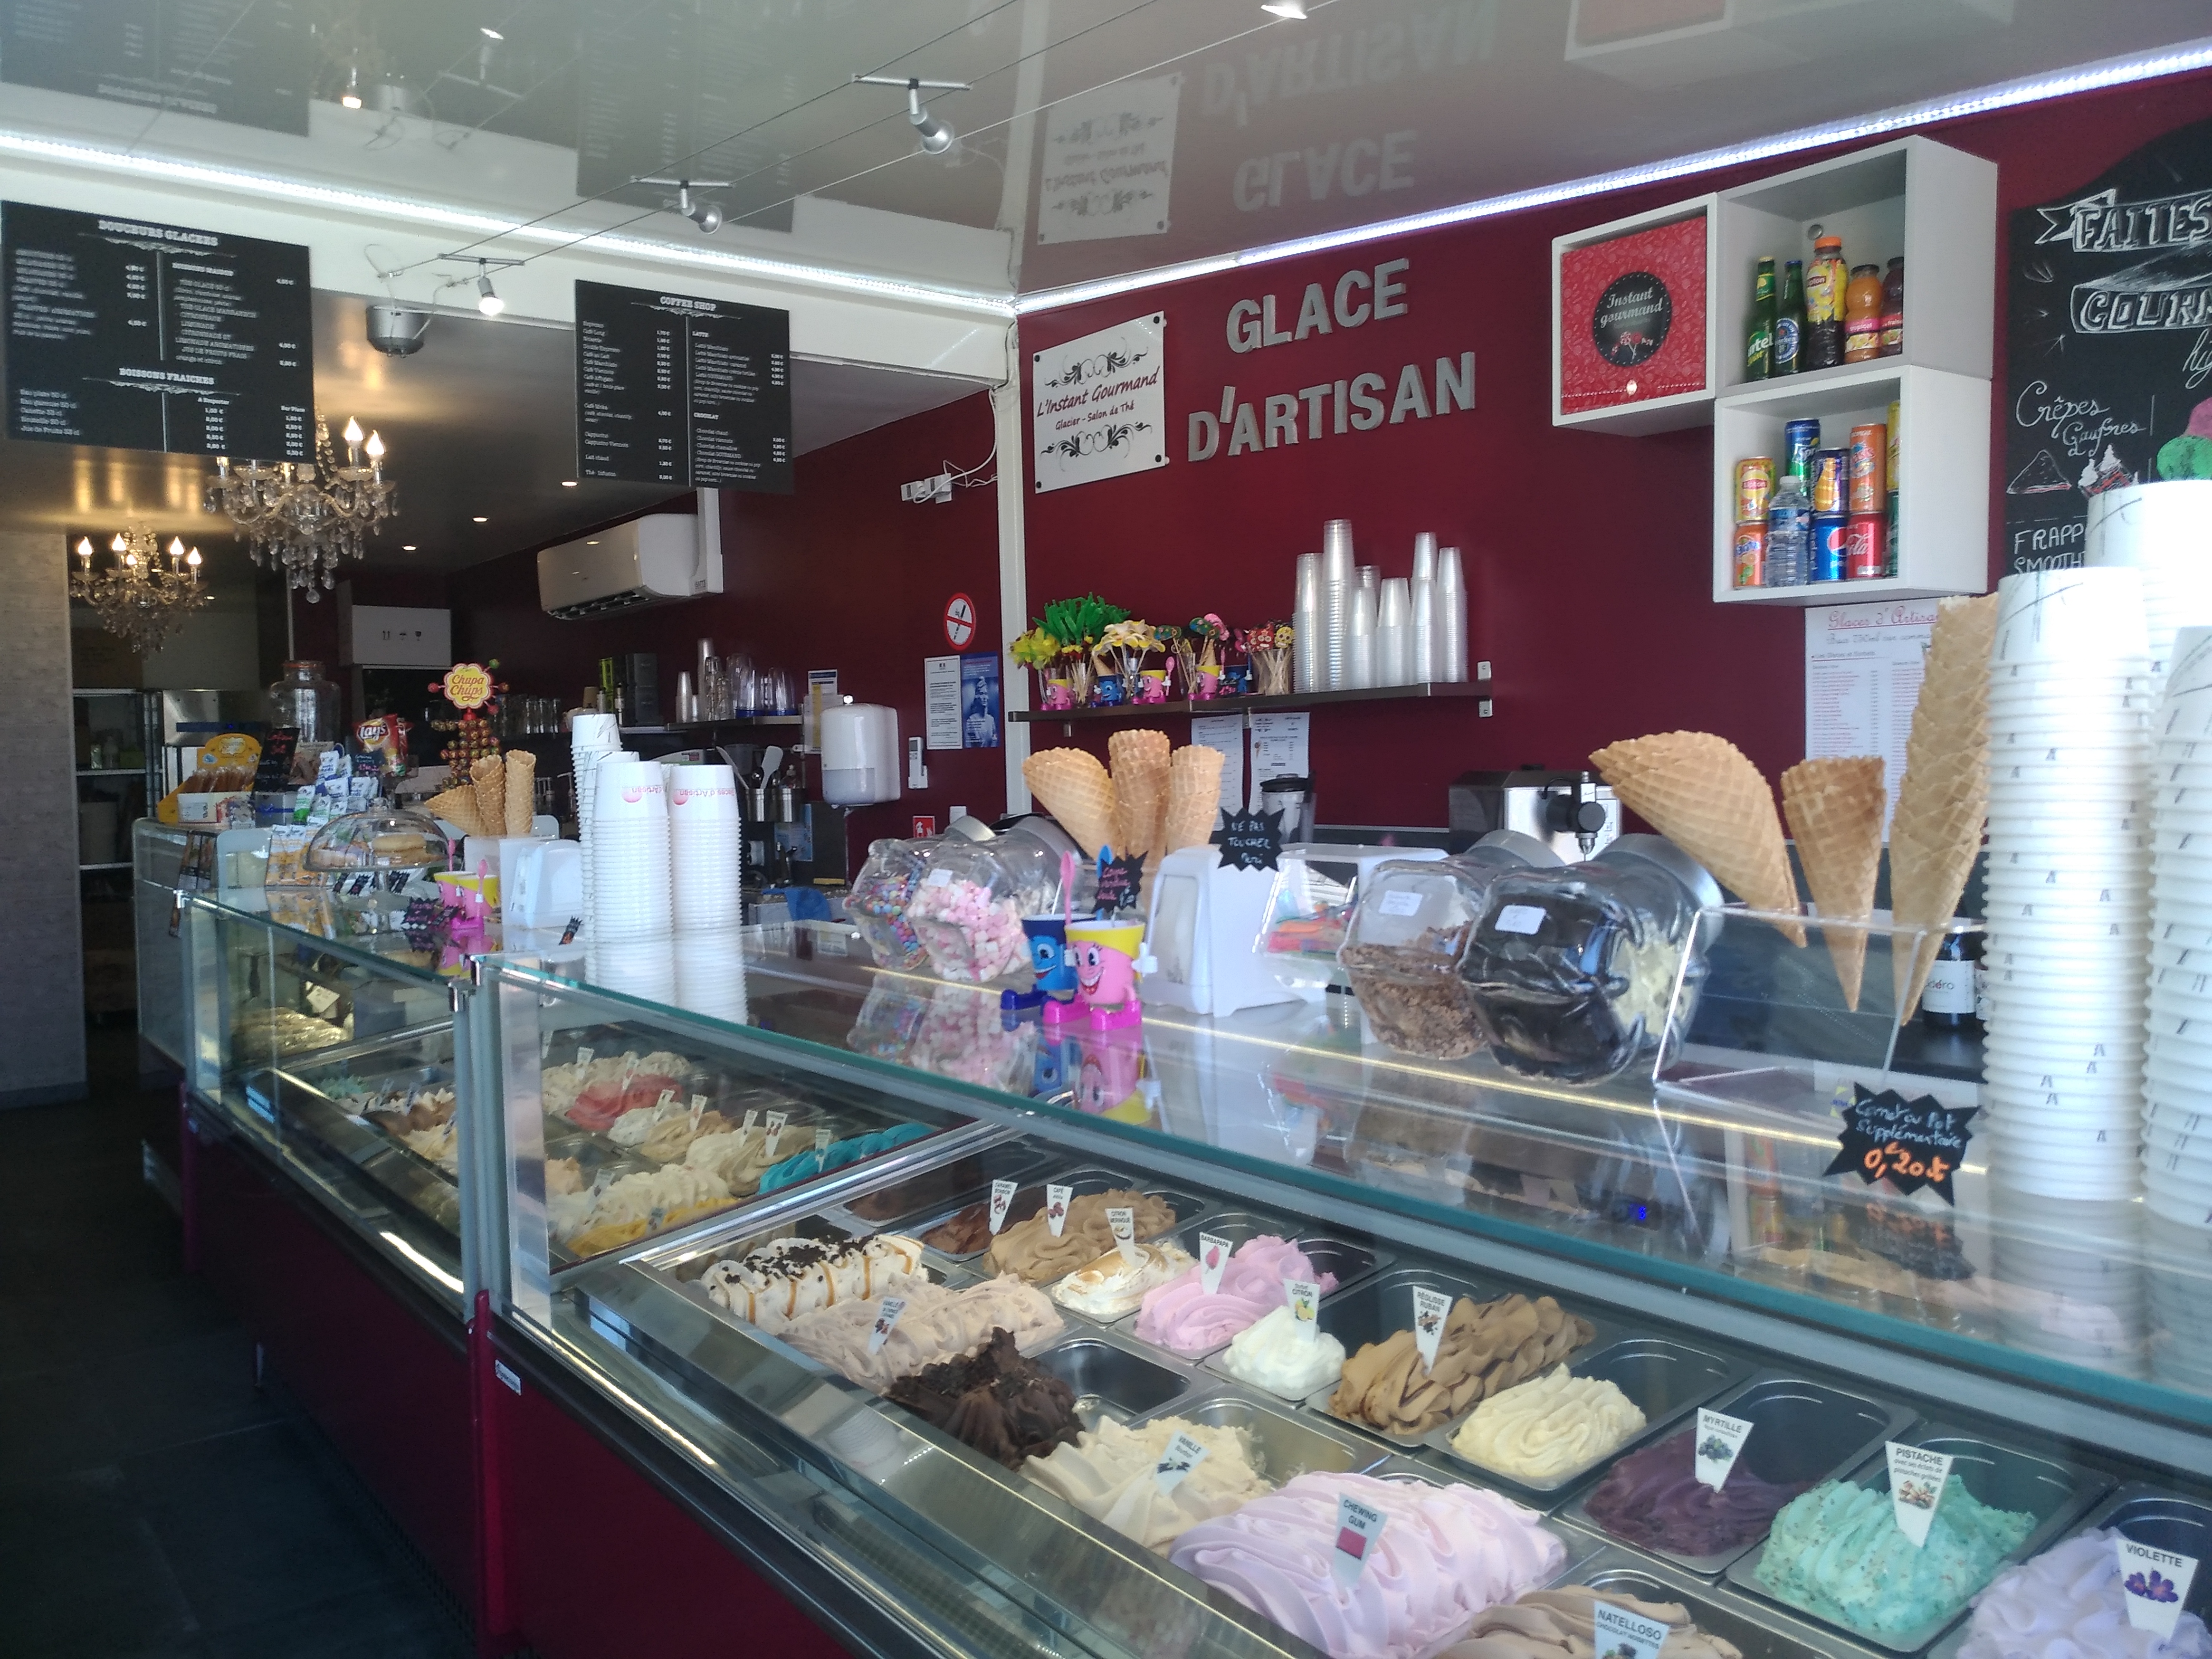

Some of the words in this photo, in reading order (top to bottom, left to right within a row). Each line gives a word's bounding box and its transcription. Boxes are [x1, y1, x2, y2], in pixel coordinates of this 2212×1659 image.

[659, 296, 694, 309] COFFEE
[694, 300, 717, 312] SHOP
[1226, 258, 1410, 353] GLACE
[1606, 286, 1654, 309] Instant
[1600, 296, 1664, 329] gourmand
[1037, 389, 1089, 418] L'Instant
[1091, 365, 1161, 402] Gourmand
[1087, 410, 1108, 422] Salon
[1109, 405, 1119, 416] de
[1120, 400, 1135, 413] Thé
[1187, 351, 1475, 462] D'ARTISAN
[2016, 380, 2110, 439] Crêpes
[2014, 522, 2086, 554] FRAPP
[2014, 550, 2086, 574] SMOOTH
[452, 675, 485, 686] Chupa
[450, 684, 483, 701] Chups
[1200, 1234, 1230, 1248] BARBAPAPA
[1292, 1288, 1313, 1297] CITRON
[1702, 1414, 1742, 1434] MYRTILLE
[1179, 1435, 1201, 1454] VANILLE
[1896, 1447, 1943, 1466] PISTACHE
[1344, 1499, 1377, 1522] CHEWING
[1348, 1515, 1366, 1530] GUM
[2126, 1543, 2183, 1568] VIOLETTE
[1598, 1609, 1661, 1640] NATELLOSO
